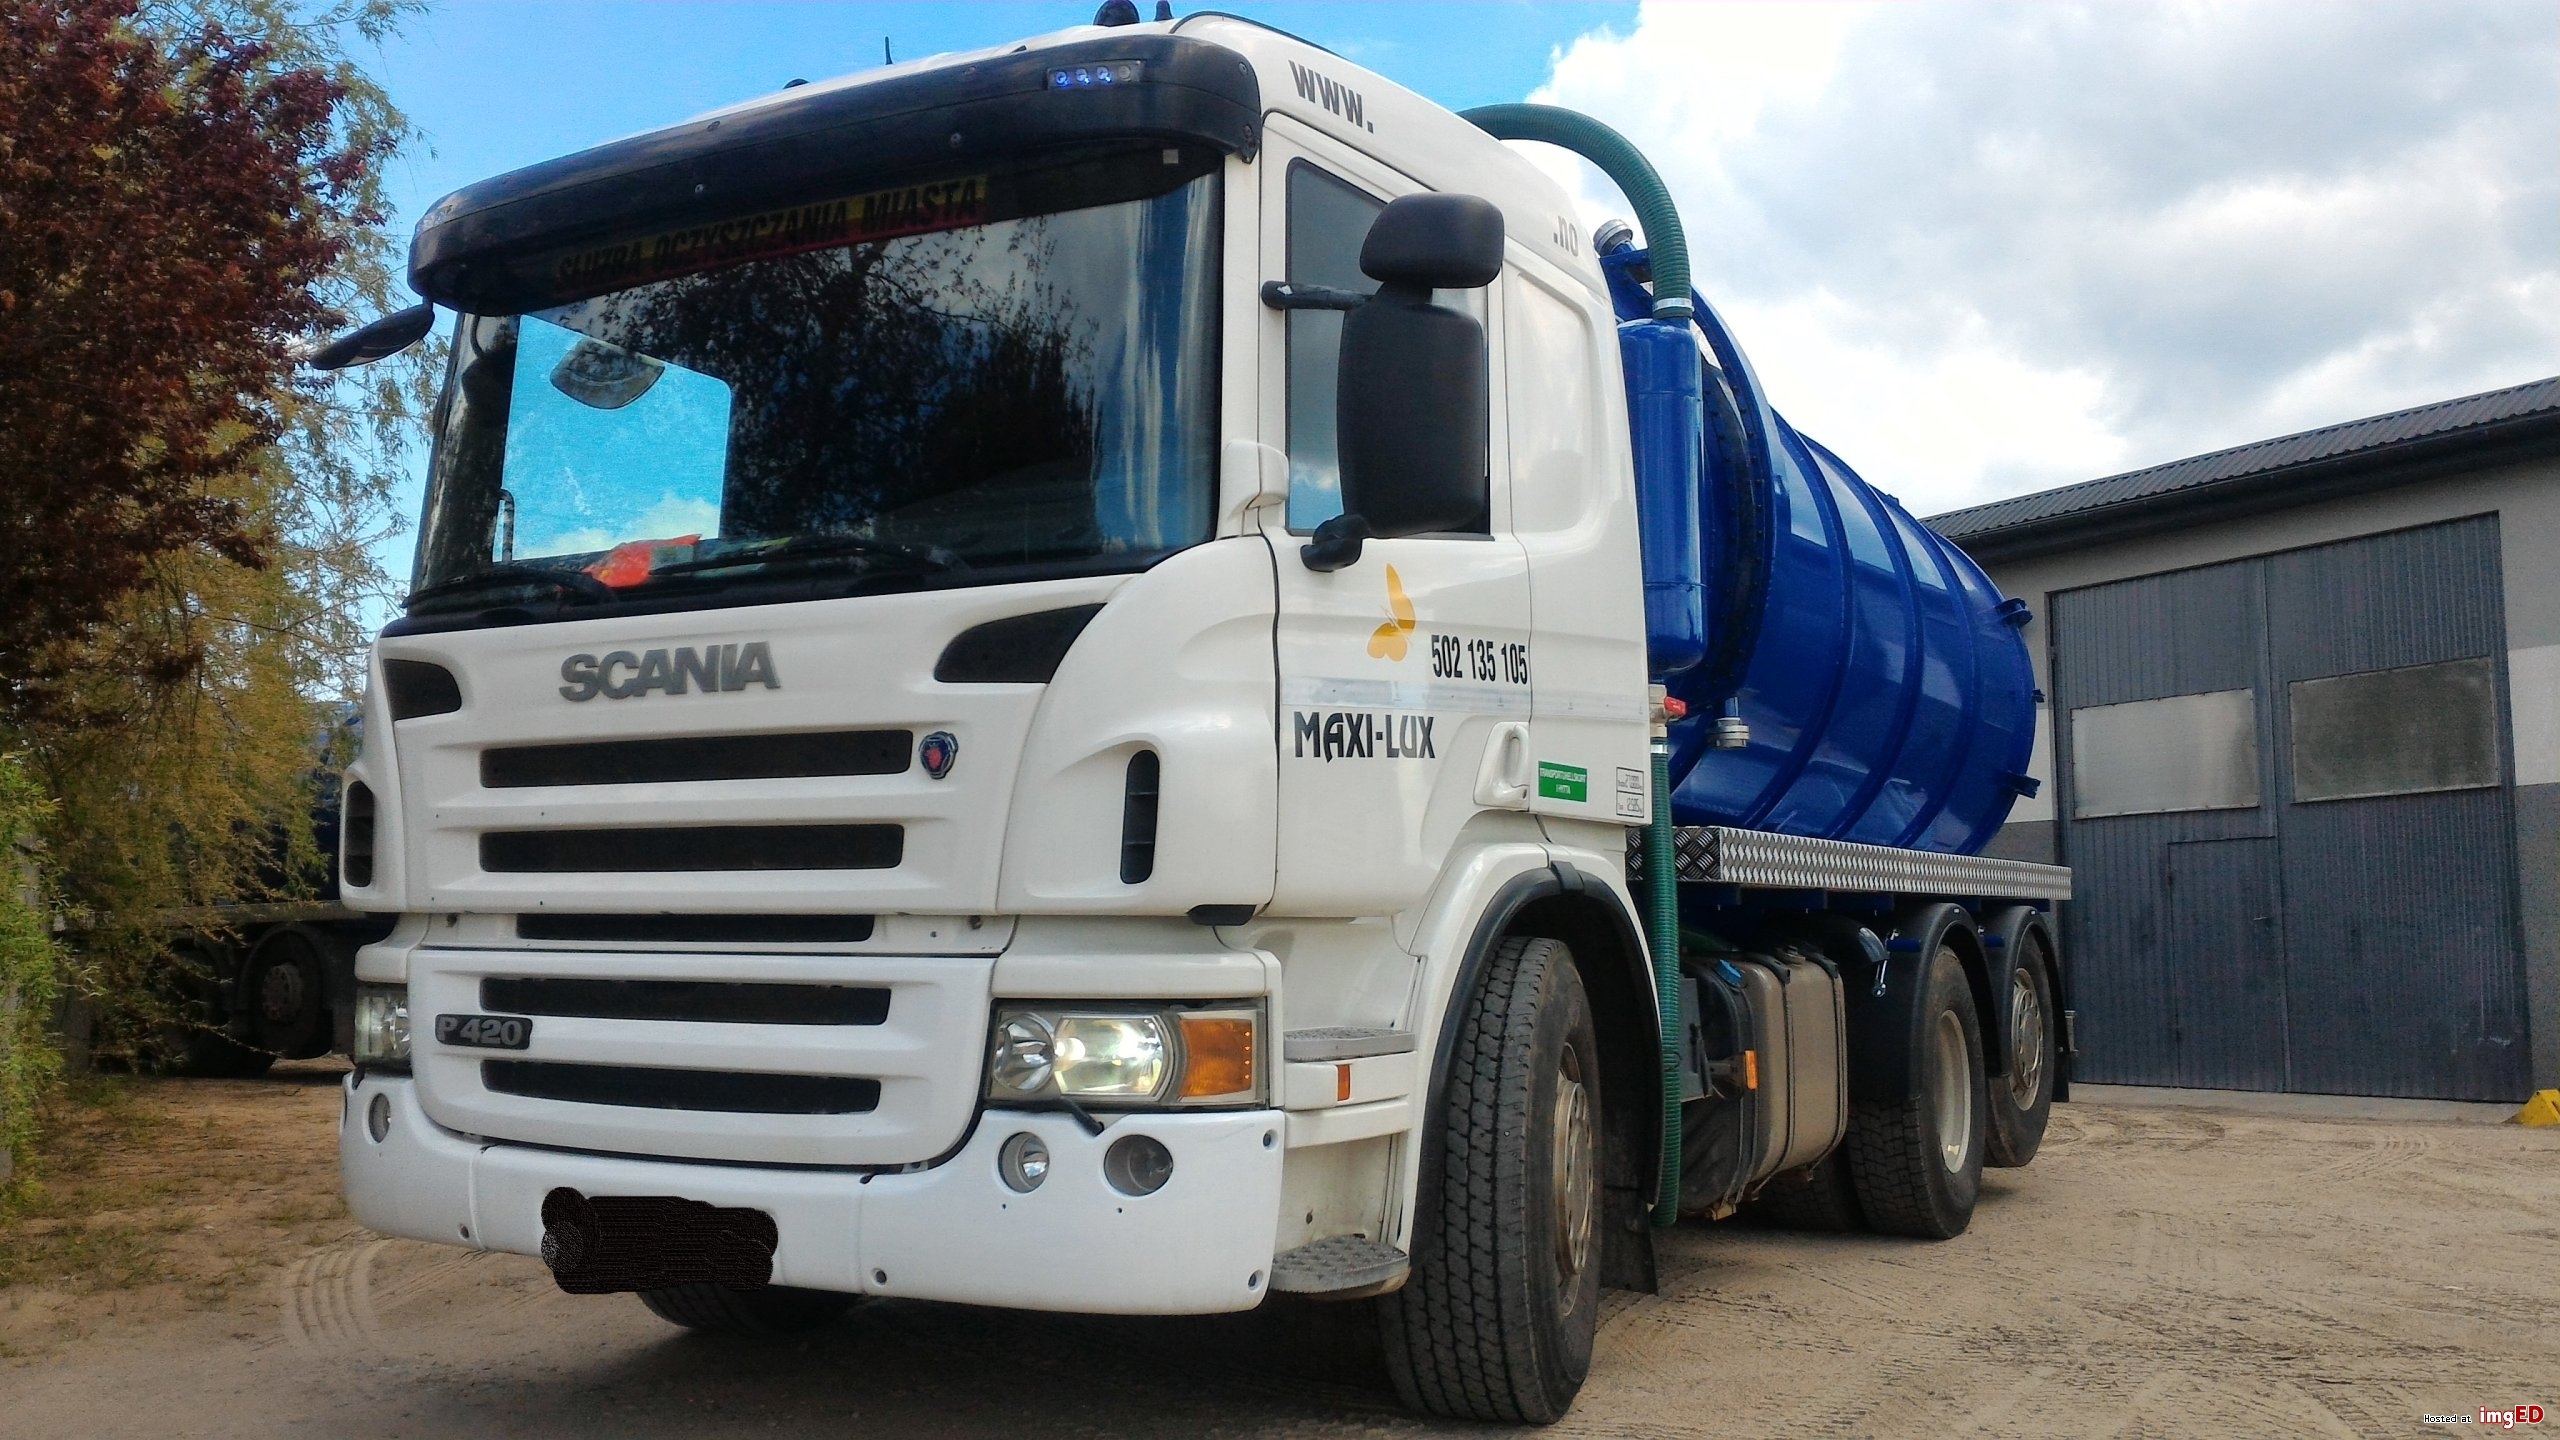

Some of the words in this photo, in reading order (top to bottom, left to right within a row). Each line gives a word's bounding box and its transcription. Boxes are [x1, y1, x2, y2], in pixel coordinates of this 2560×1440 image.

[863, 178, 978, 234] MIASTA
[558, 641, 781, 702] SCANIA
[1431, 634, 1463, 678] 502
[1467, 638, 1496, 682] 135
[1501, 642, 1528, 685] 105
[1294, 711, 1436, 763] MAXI-LUX
[460, 1018, 523, 1046] 420
